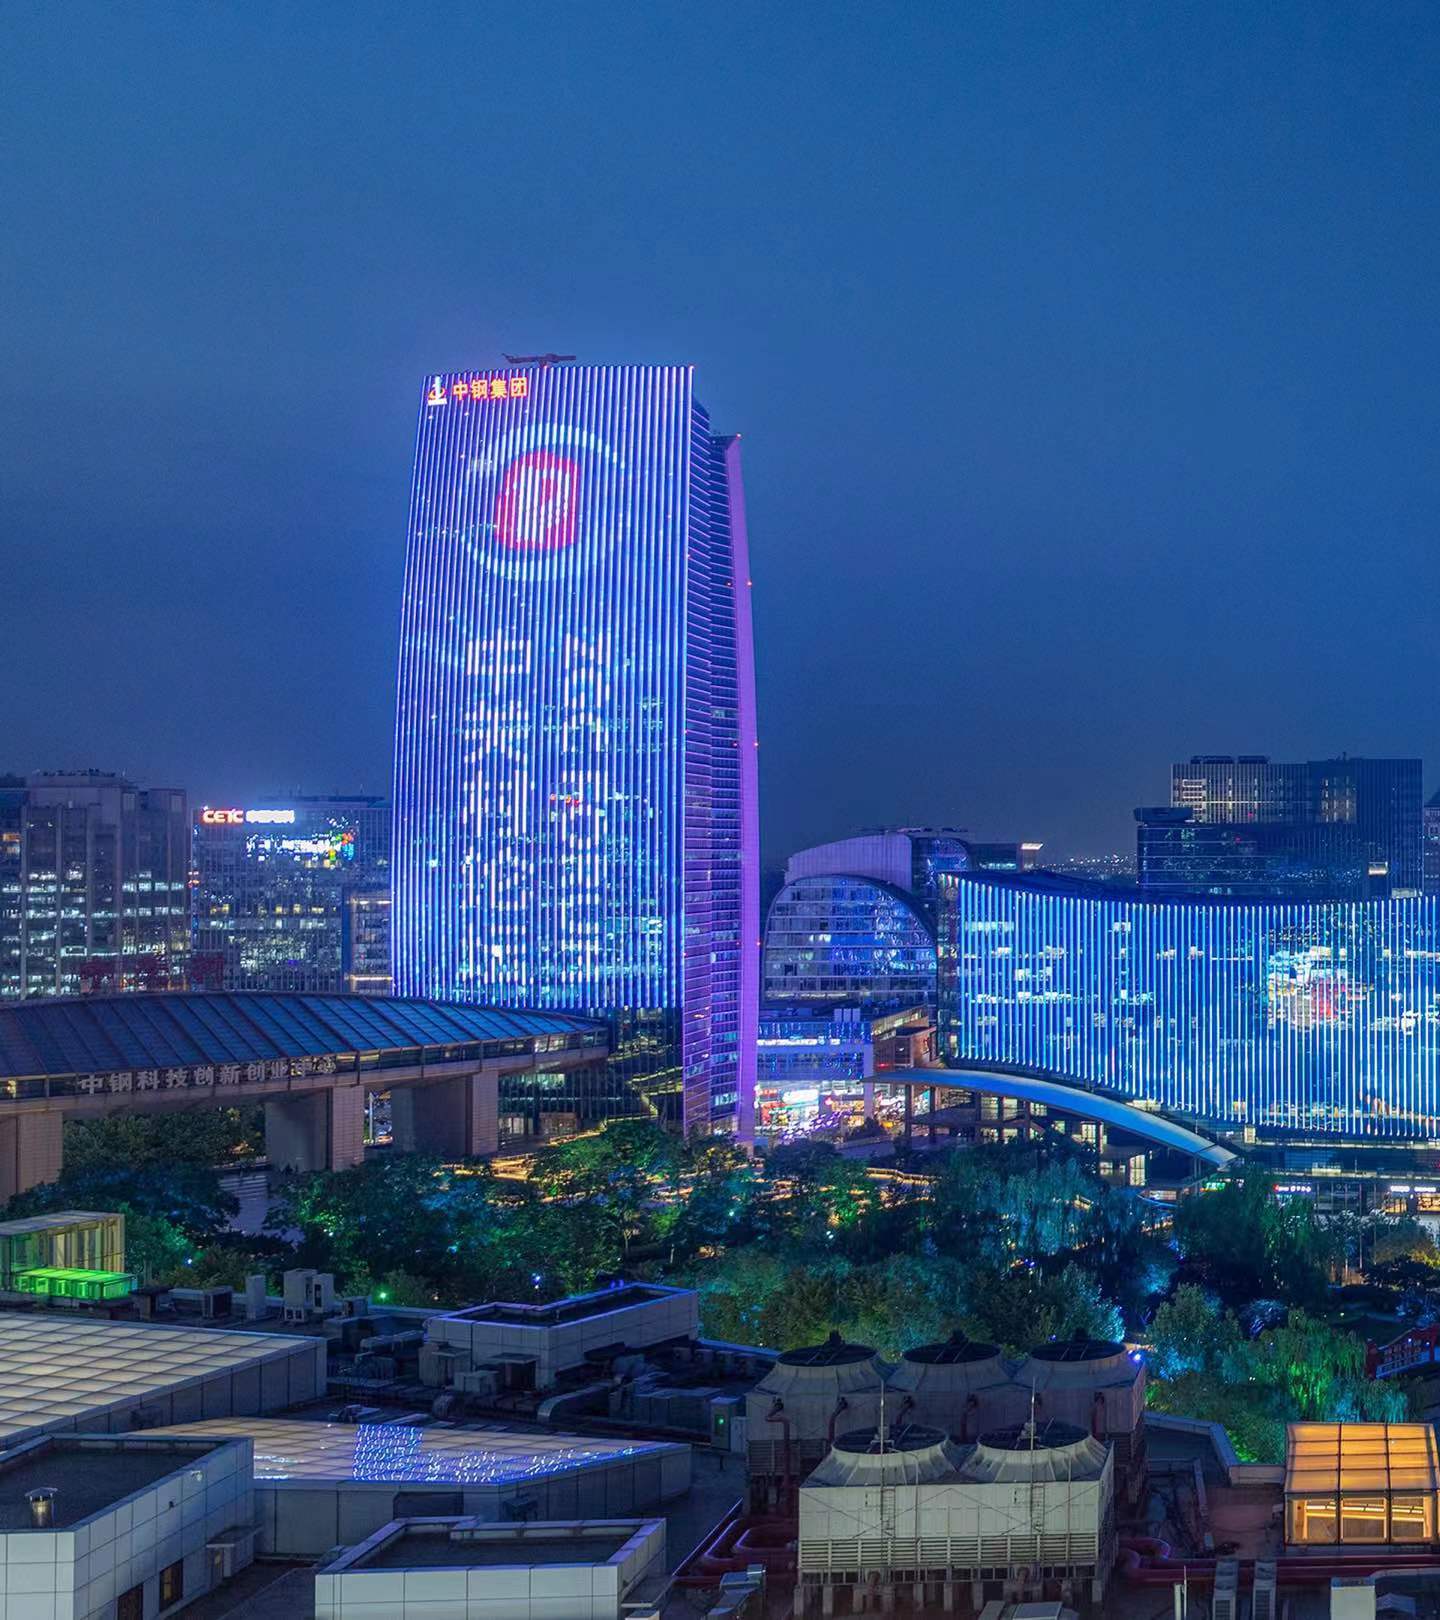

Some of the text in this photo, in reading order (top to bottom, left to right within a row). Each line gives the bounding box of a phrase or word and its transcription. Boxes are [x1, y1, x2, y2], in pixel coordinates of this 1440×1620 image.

[453, 377, 528, 400] 中钢集团
[203, 809, 244, 823] CETC
[461, 627, 534, 983] 中关村论坛
[559, 632, 610, 982] ZGC FORUM
